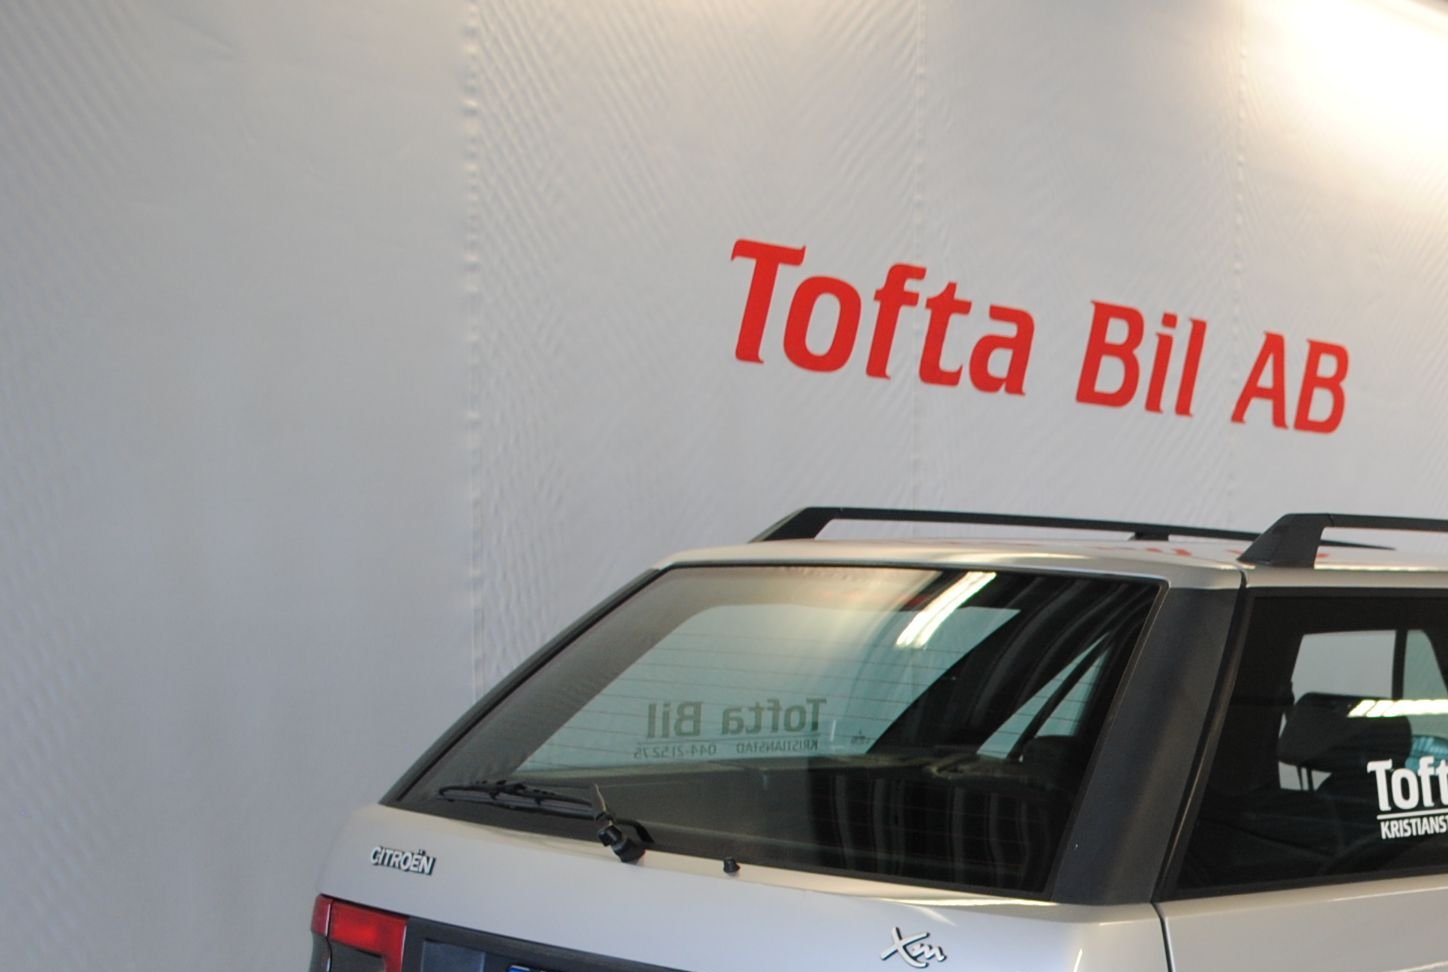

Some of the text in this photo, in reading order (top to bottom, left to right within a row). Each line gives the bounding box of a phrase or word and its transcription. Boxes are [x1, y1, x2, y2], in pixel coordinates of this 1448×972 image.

[731, 239, 1349, 434] Tofta Bil AB
[370, 846, 436, 876] CITROËN
